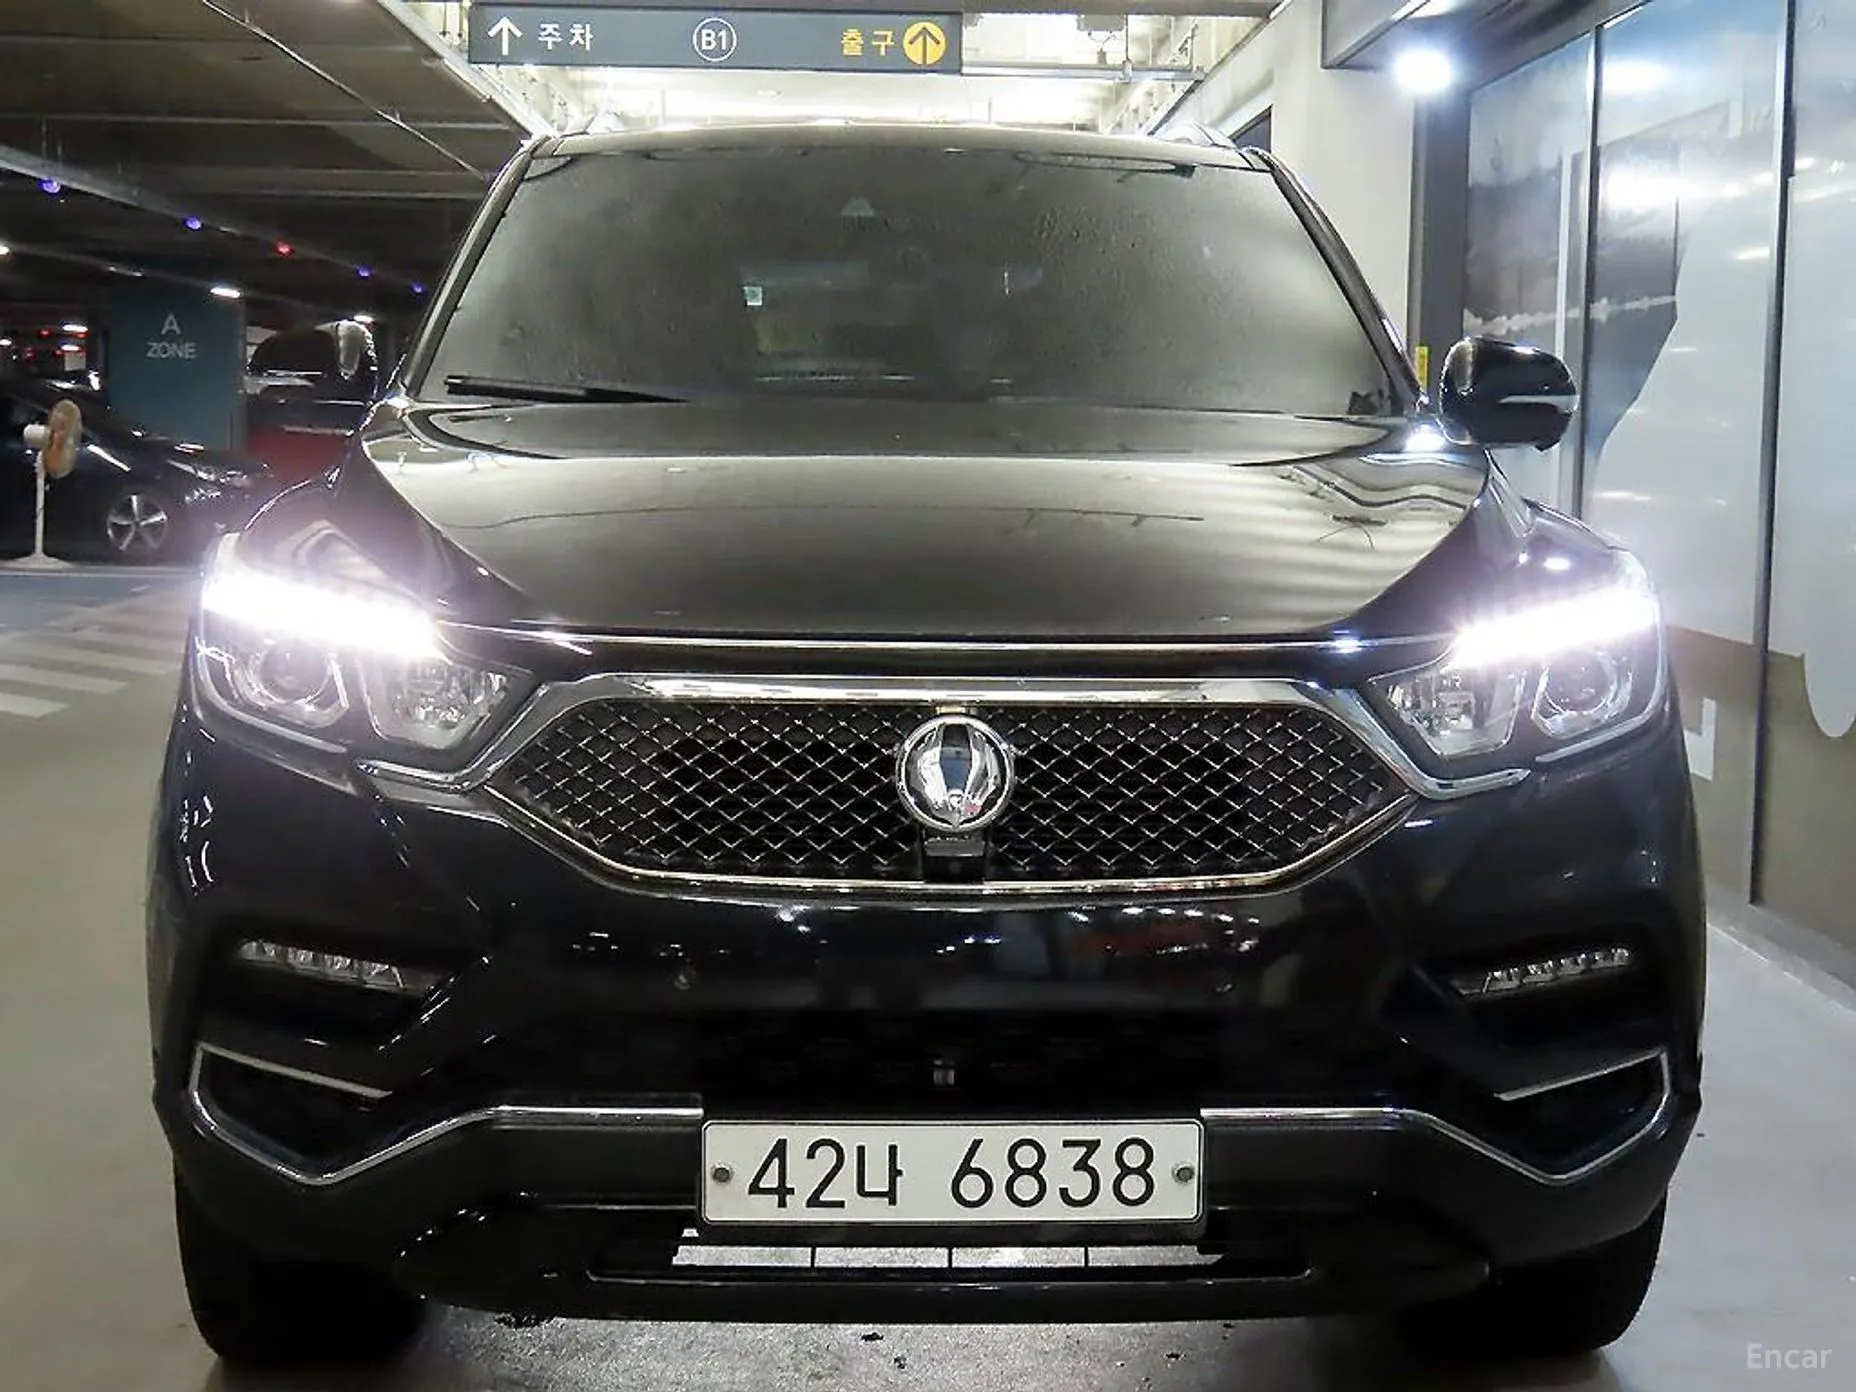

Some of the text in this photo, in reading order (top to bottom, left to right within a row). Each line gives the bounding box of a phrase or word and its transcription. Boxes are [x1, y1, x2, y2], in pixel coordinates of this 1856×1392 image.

[538, 23, 593, 50] 주차
[700, 28, 730, 51] B1
[840, 29, 895, 57] 출구
[161, 312, 181, 335] A
[146, 342, 198, 359] ZONE
[748, 1137, 1155, 1208] 42나 6838
